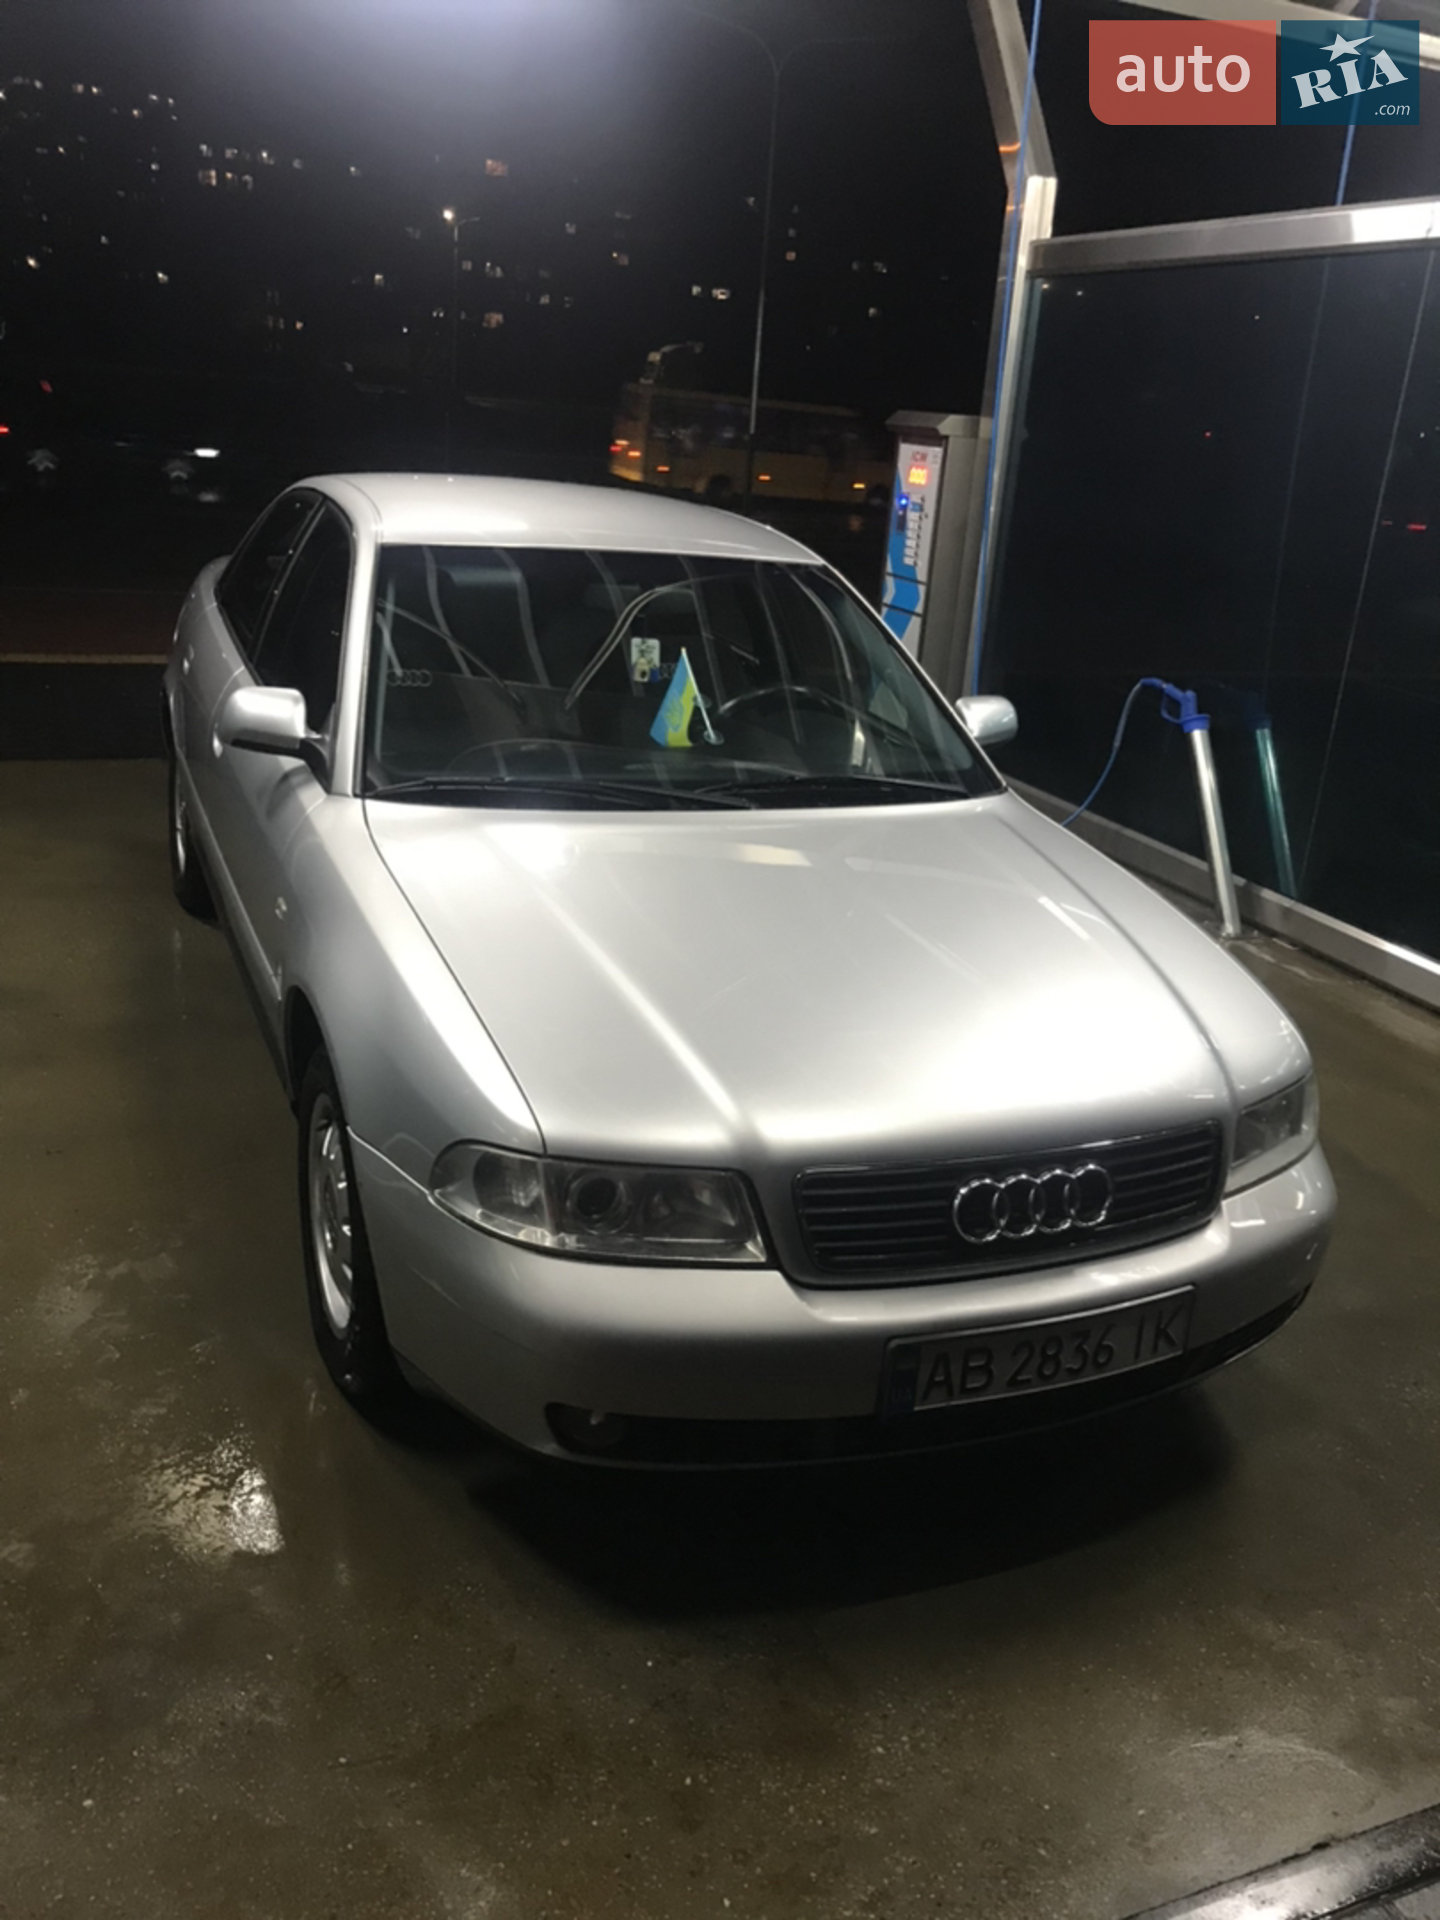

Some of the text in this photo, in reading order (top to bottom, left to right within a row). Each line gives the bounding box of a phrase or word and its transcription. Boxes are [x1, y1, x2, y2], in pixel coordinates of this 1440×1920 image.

[922, 1303, 1183, 1401] AB 2836 IK
